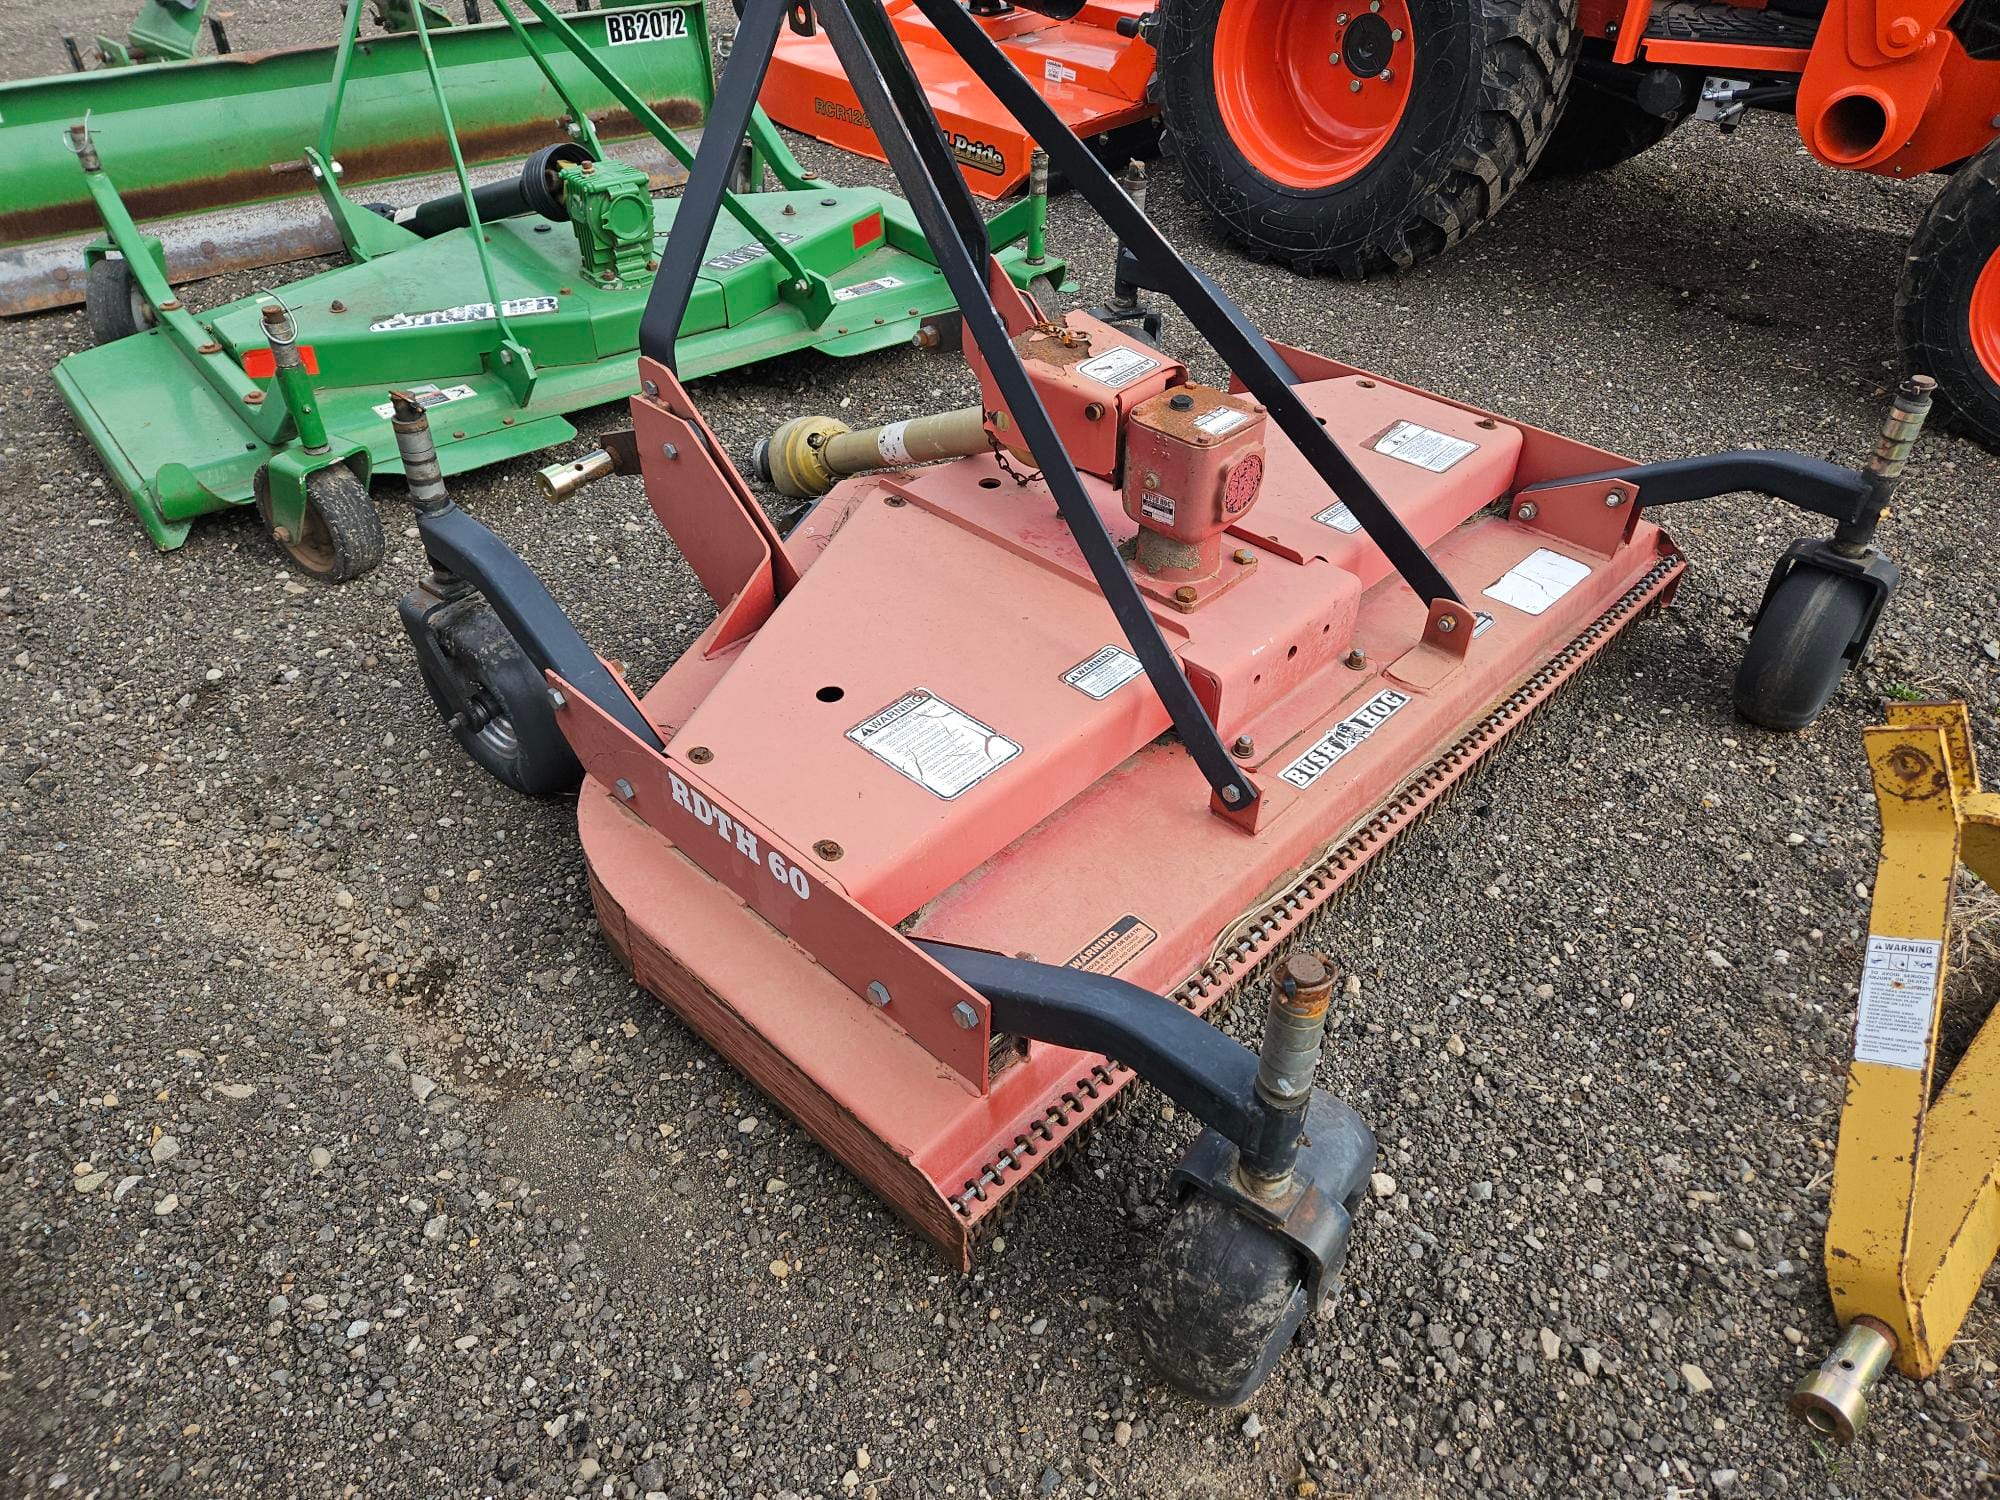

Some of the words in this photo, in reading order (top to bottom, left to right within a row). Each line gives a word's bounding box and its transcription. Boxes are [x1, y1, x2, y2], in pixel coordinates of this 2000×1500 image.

[607, 8, 686, 43] BB2072
[955, 135, 1003, 168] Pride
[1076, 650, 1115, 675] WARNING
[869, 695, 923, 730] WARNING
[1284, 741, 1342, 784] BUSH
[1358, 692, 1403, 727] HOG
[668, 771, 760, 865] RDTH
[768, 851, 810, 900] 60
[1069, 930, 1120, 969] WARNING
[1099, 946, 1117, 961] INJURY
[1885, 943, 1933, 954] WARNING
